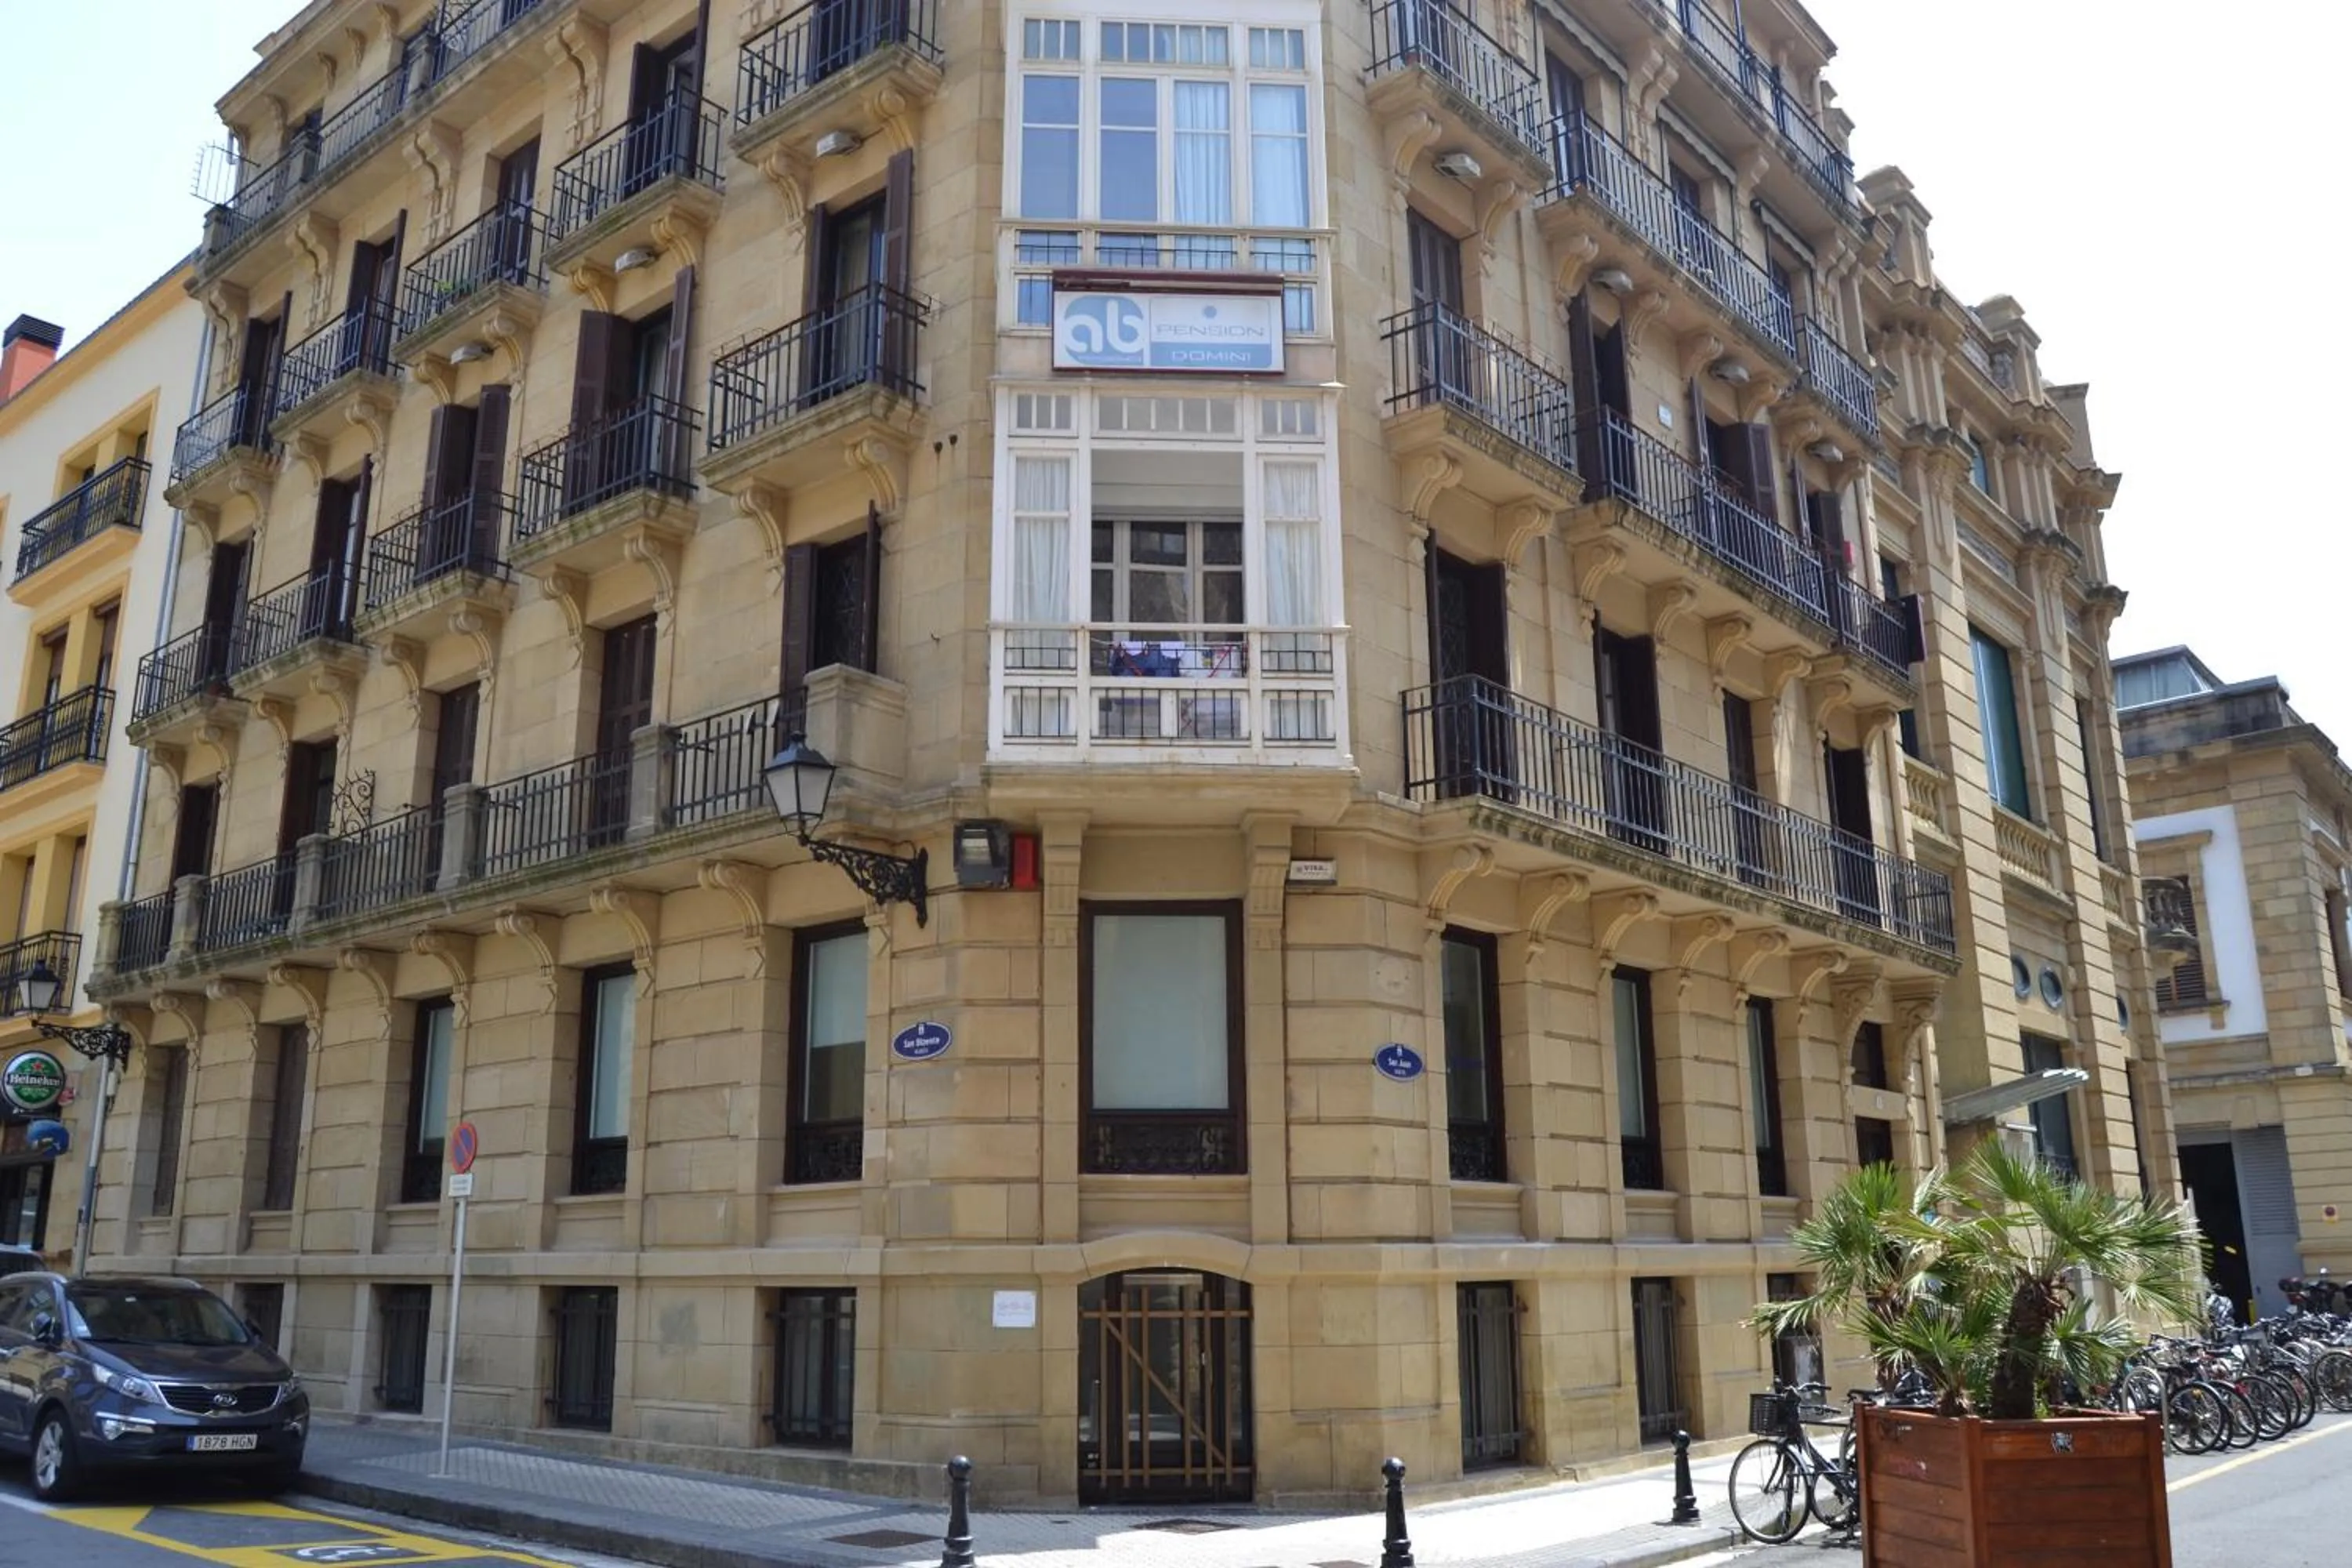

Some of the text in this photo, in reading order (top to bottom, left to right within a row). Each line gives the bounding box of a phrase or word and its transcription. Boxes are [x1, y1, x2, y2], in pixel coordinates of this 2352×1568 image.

[1156, 324, 1265, 337] PENSION
[1171, 350, 1250, 362] DOMINI
[903, 1038, 915, 1048] San
[1388, 1056, 1398, 1066] San
[231, 1436, 256, 1447] HGN
